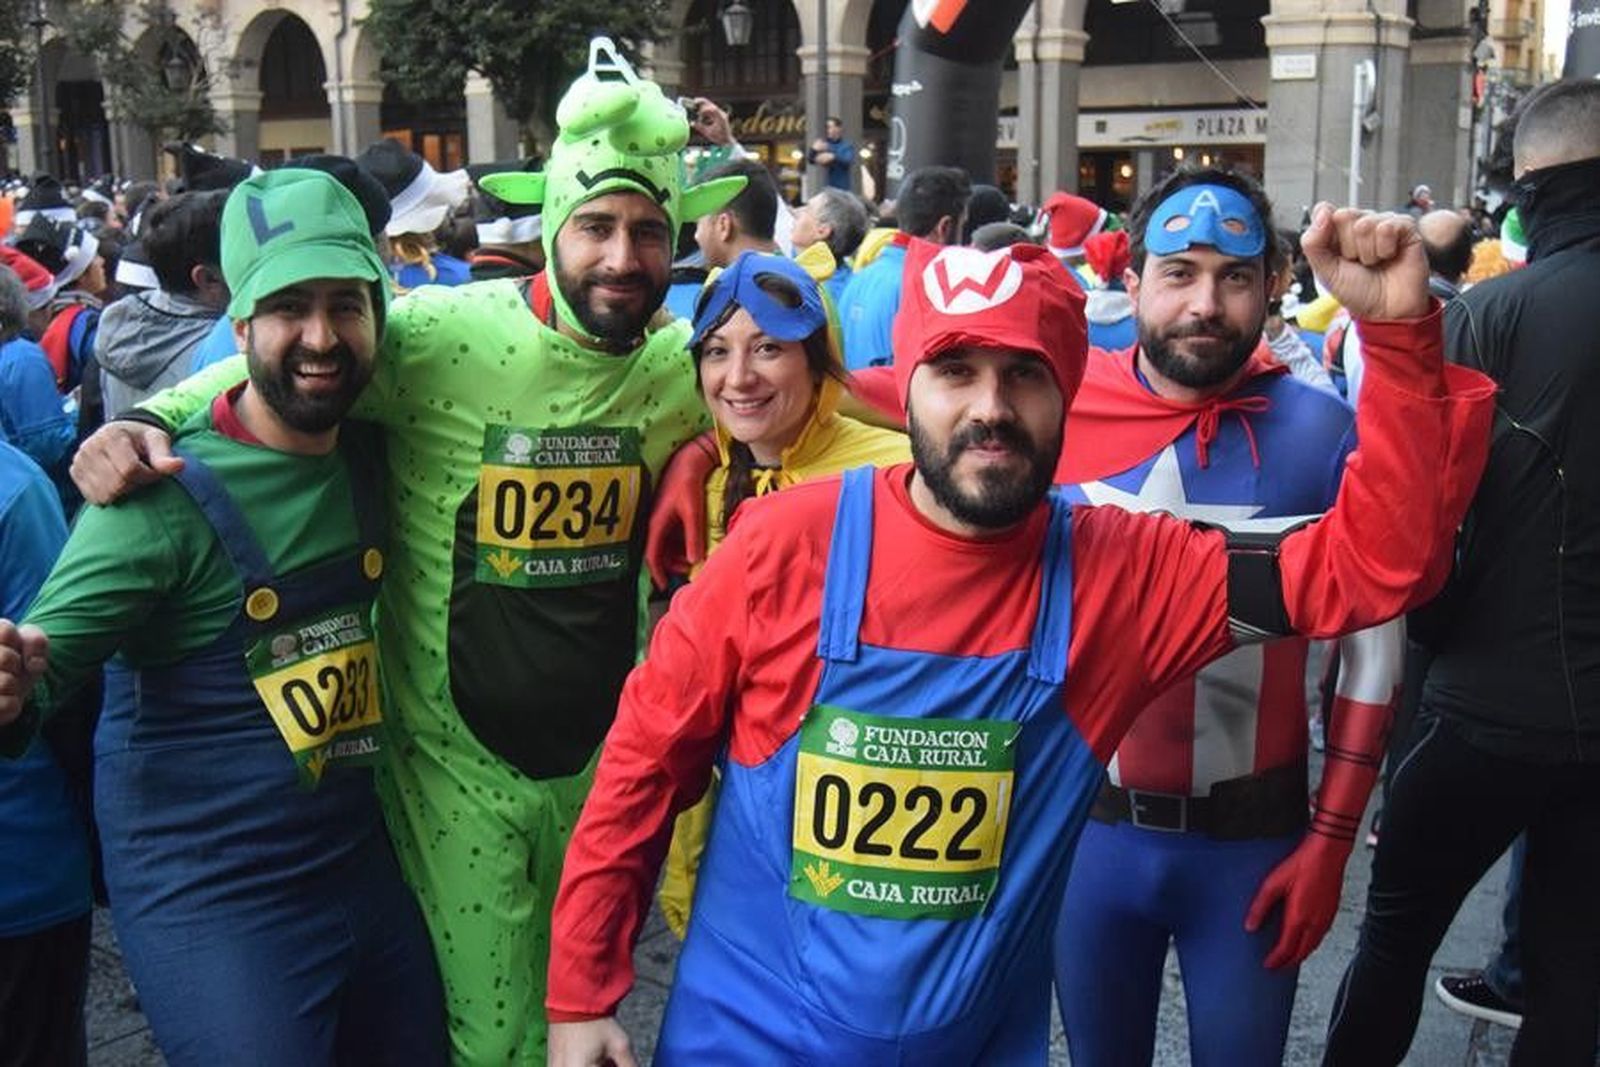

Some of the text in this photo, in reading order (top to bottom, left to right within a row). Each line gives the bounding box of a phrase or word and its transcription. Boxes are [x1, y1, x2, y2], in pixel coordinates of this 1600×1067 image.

[1196, 117, 1246, 137] PLAZA
[1189, 189, 1221, 216] A
[245, 194, 295, 247] L
[537, 435, 621, 450] FUNDACION
[535, 450, 621, 464] CAJA RURAL
[494, 477, 622, 541] 0234
[524, 554, 622, 575] CAJA RURAL
[281, 655, 370, 737] 0233
[863, 725, 990, 749] FUNDACION
[863, 744, 987, 767] CAJA RURAL
[812, 774, 988, 861] 0222
[846, 879, 986, 905] CAJA RURAL
